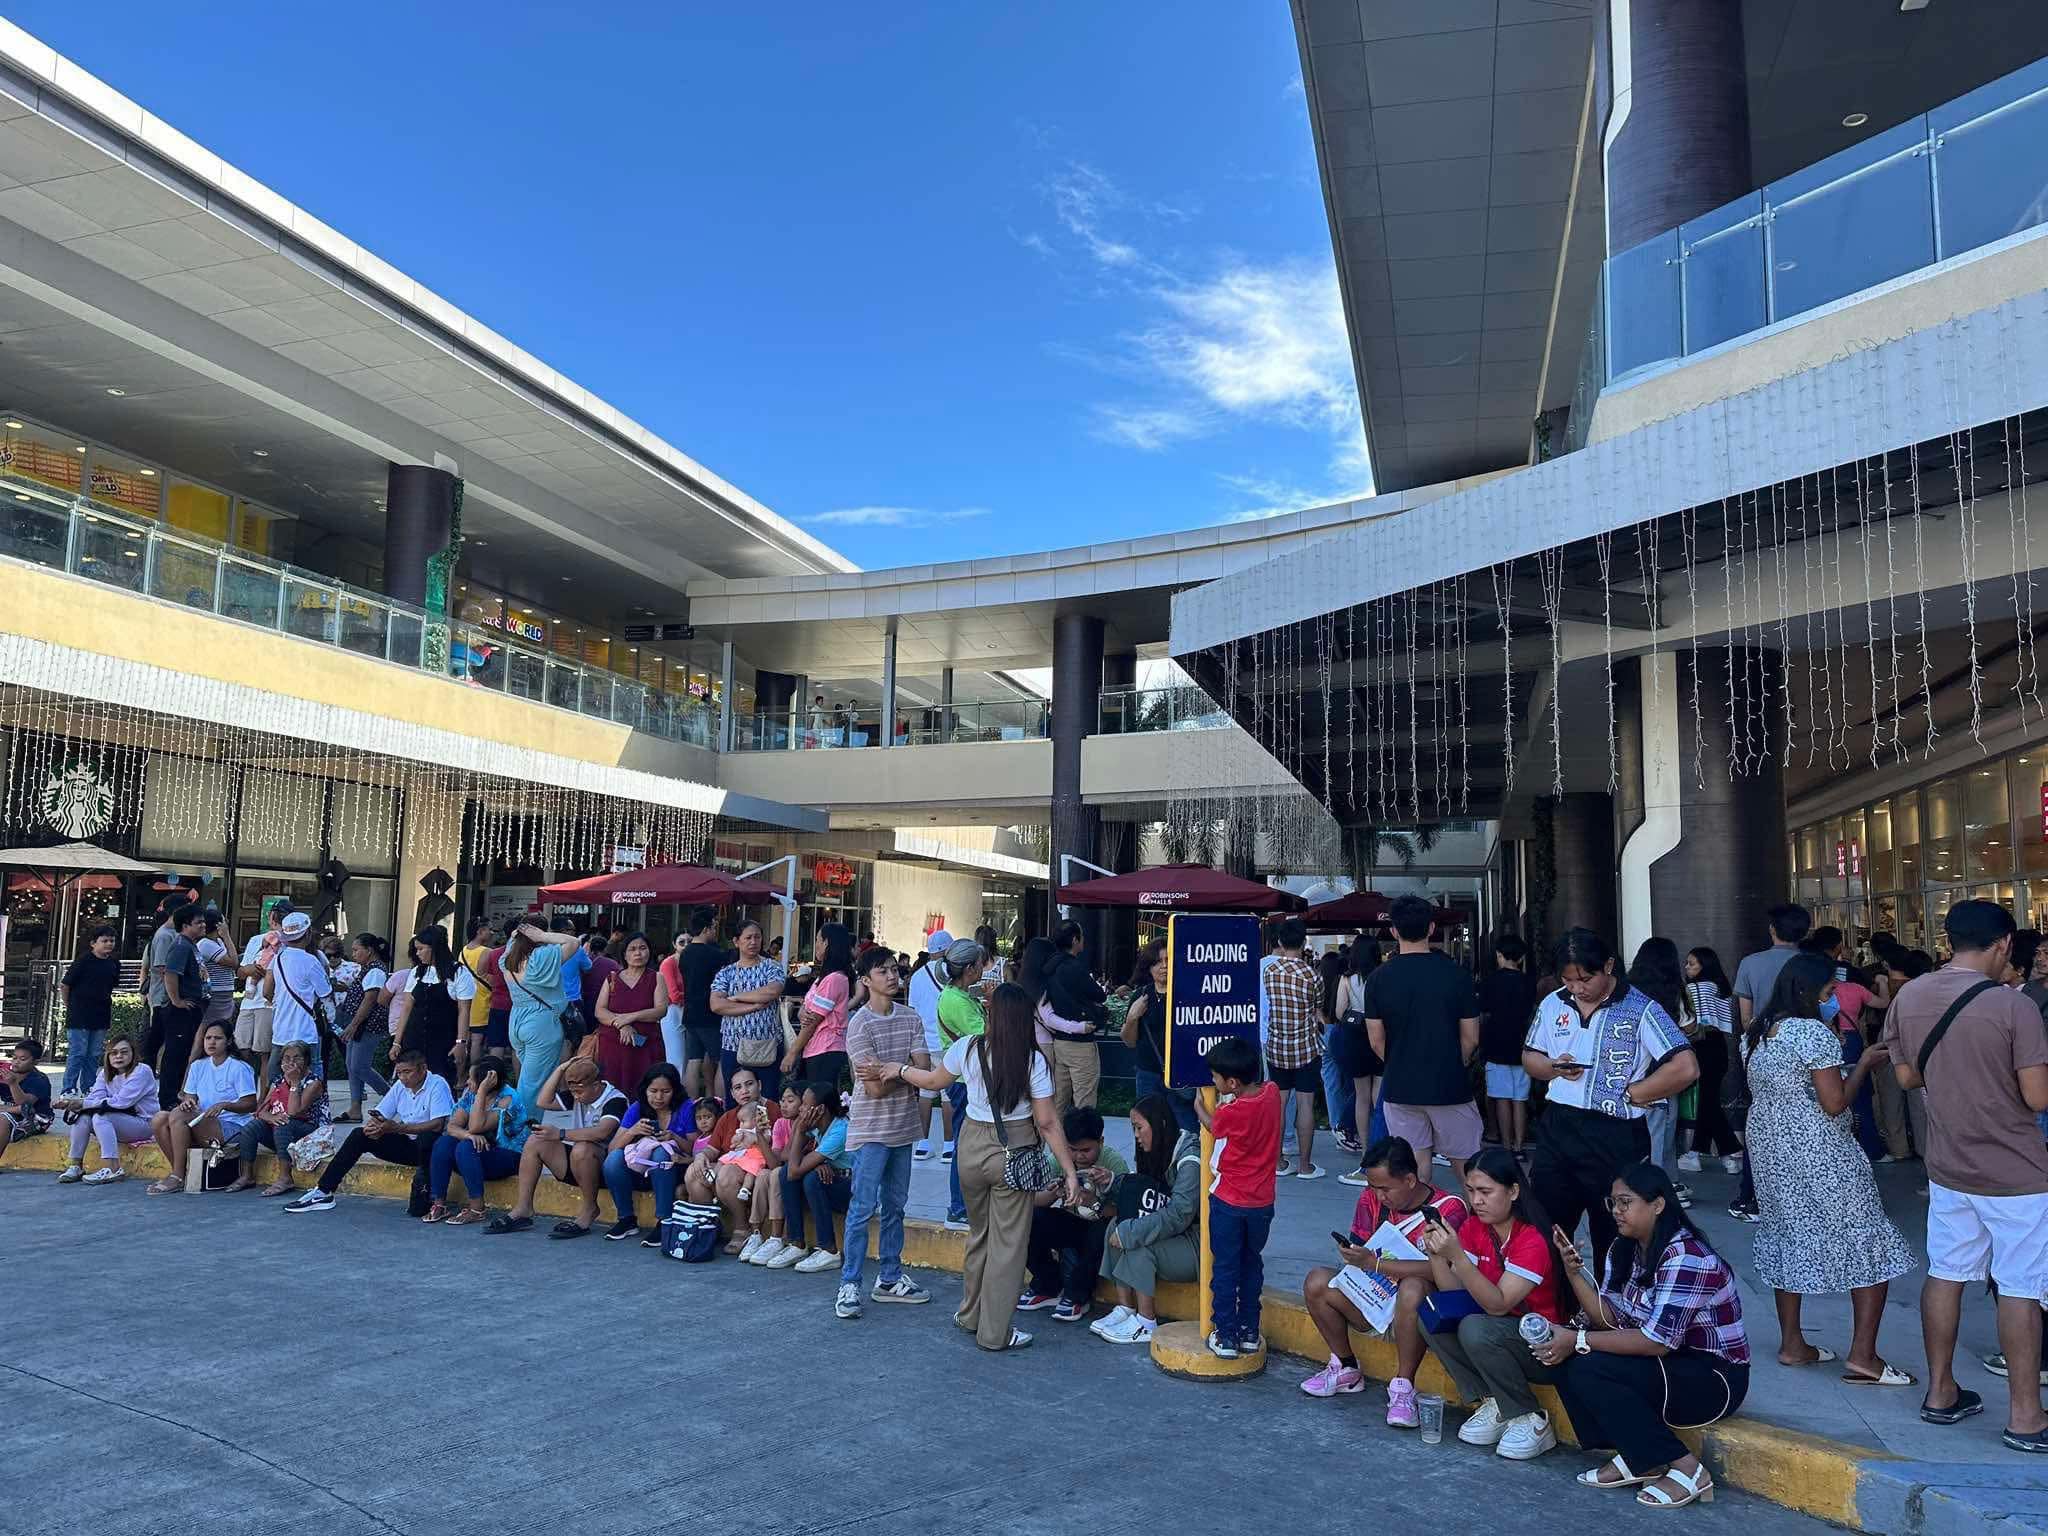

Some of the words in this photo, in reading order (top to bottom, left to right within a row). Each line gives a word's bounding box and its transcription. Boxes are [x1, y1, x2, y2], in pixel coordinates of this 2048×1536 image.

[506, 616, 545, 642] WORLD
[1187, 944, 1248, 963] LOADING
[1201, 974, 1232, 994] AND
[1175, 1004, 1257, 1026] UNLOADING
[1197, 1036, 1235, 1057] ON
